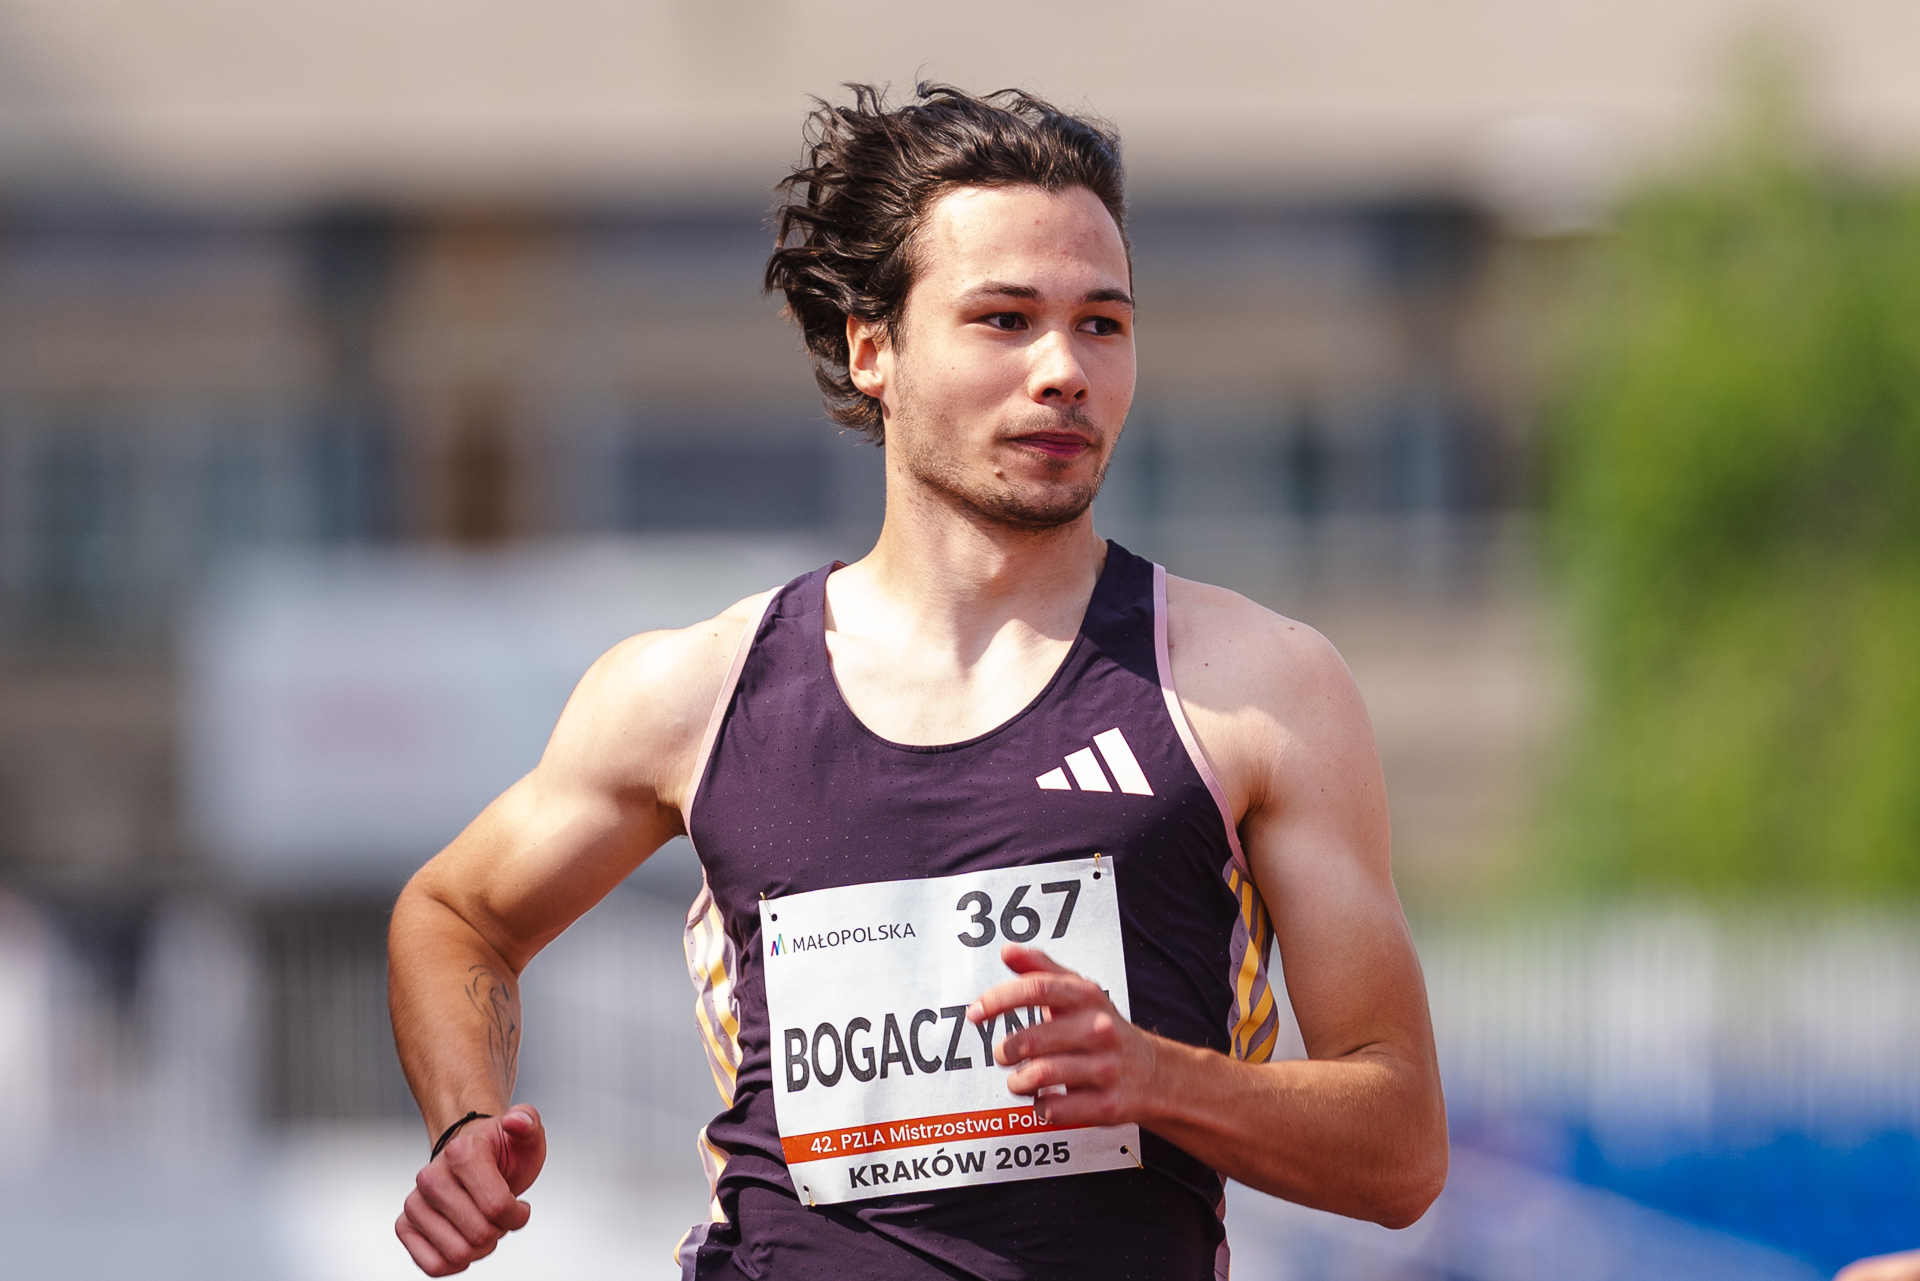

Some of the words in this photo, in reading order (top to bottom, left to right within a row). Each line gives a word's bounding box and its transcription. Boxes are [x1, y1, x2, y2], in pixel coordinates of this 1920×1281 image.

[792, 922, 917, 953] MAŁOPOLSKA
[955, 878, 1082, 948] 367
[783, 989, 1111, 1094] BOGACZY
[810, 1135, 838, 1154] 42.
[840, 1129, 886, 1150] PZLA
[889, 1116, 1003, 1143] Mistrzostwa
[1007, 1109, 1053, 1129] Pols
[848, 1147, 987, 1189] KRAKÓW
[994, 1140, 1071, 1171] 2025
